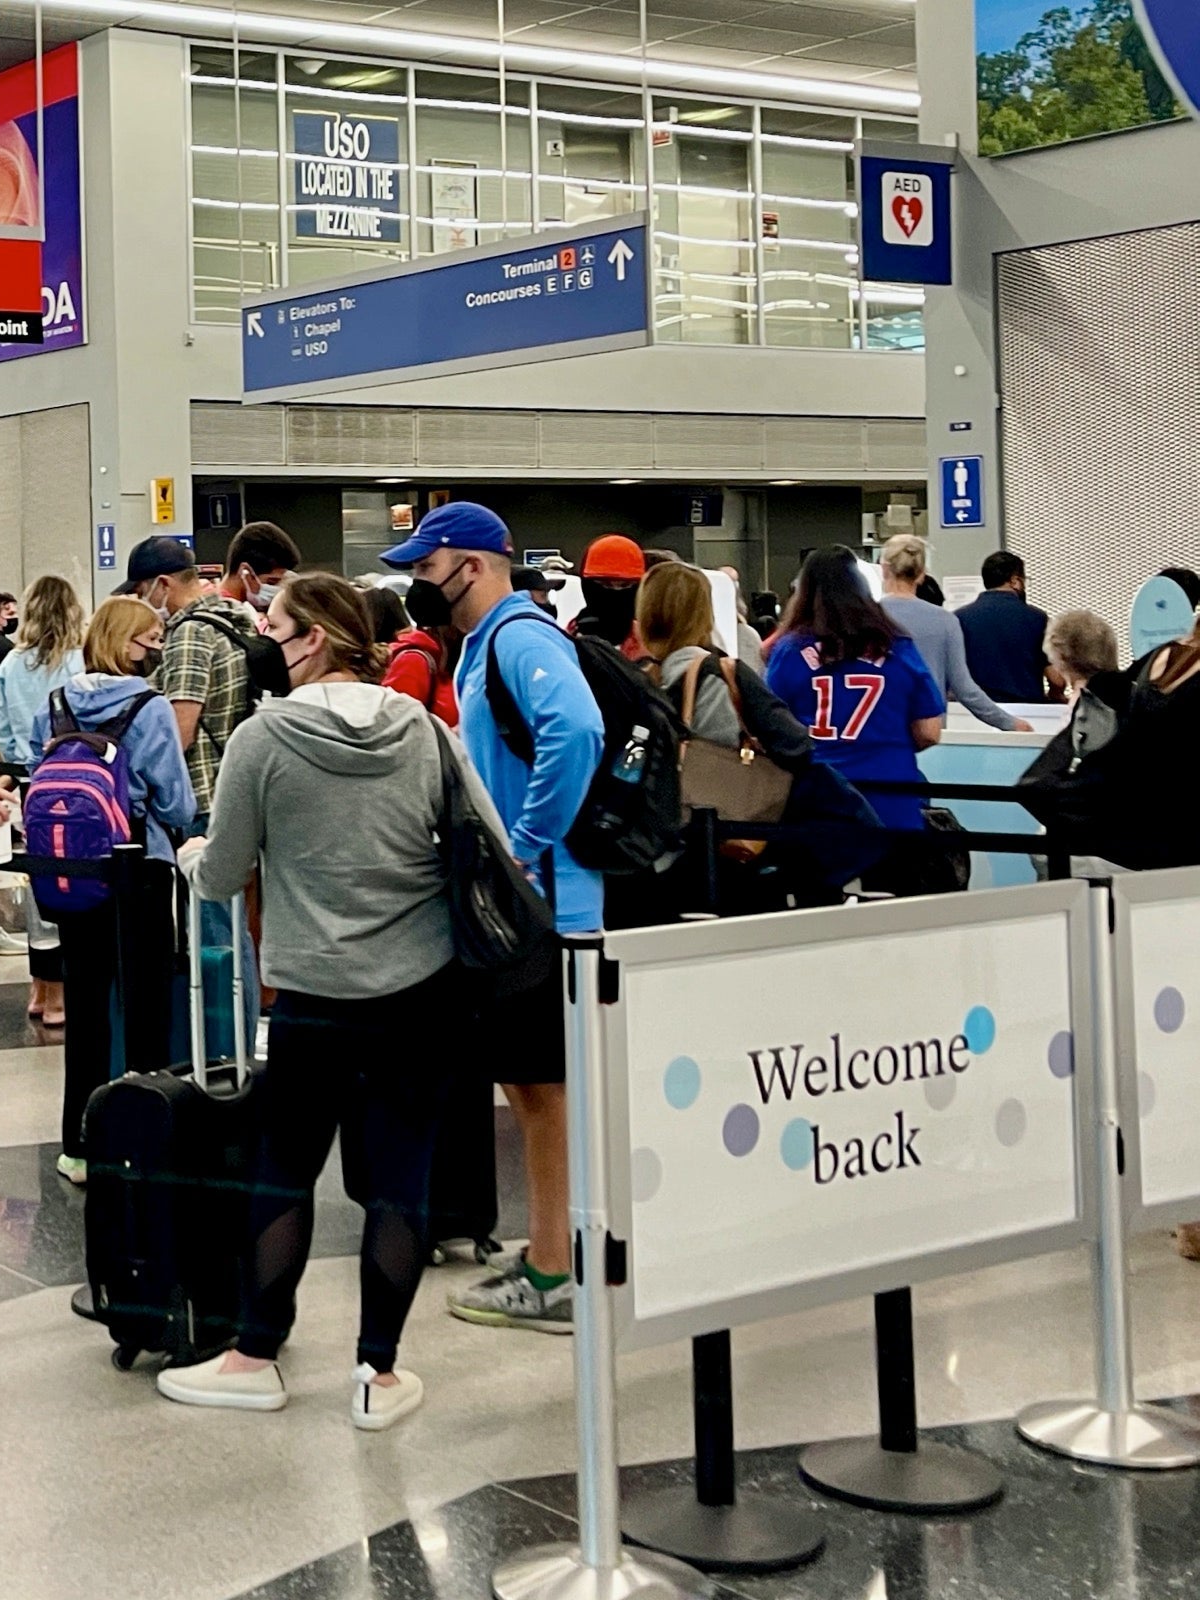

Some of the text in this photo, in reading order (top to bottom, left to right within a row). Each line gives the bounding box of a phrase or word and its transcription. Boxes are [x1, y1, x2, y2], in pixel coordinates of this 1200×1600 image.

[324, 120, 370, 160] USO
[301, 162, 394, 200] LOCATED IN THE
[894, 178, 921, 192] AED
[316, 205, 381, 237] MEZZANINE
[502, 252, 572, 279] Terminal 2
[465, 271, 591, 308] Concourses E F G
[290, 297, 356, 321] Elevators To:
[304, 318, 341, 337] Chapel
[304, 341, 328, 357] USO
[808, 674, 885, 740] 17
[747, 1033, 970, 1105] Welcome
[810, 1111, 922, 1185] back
